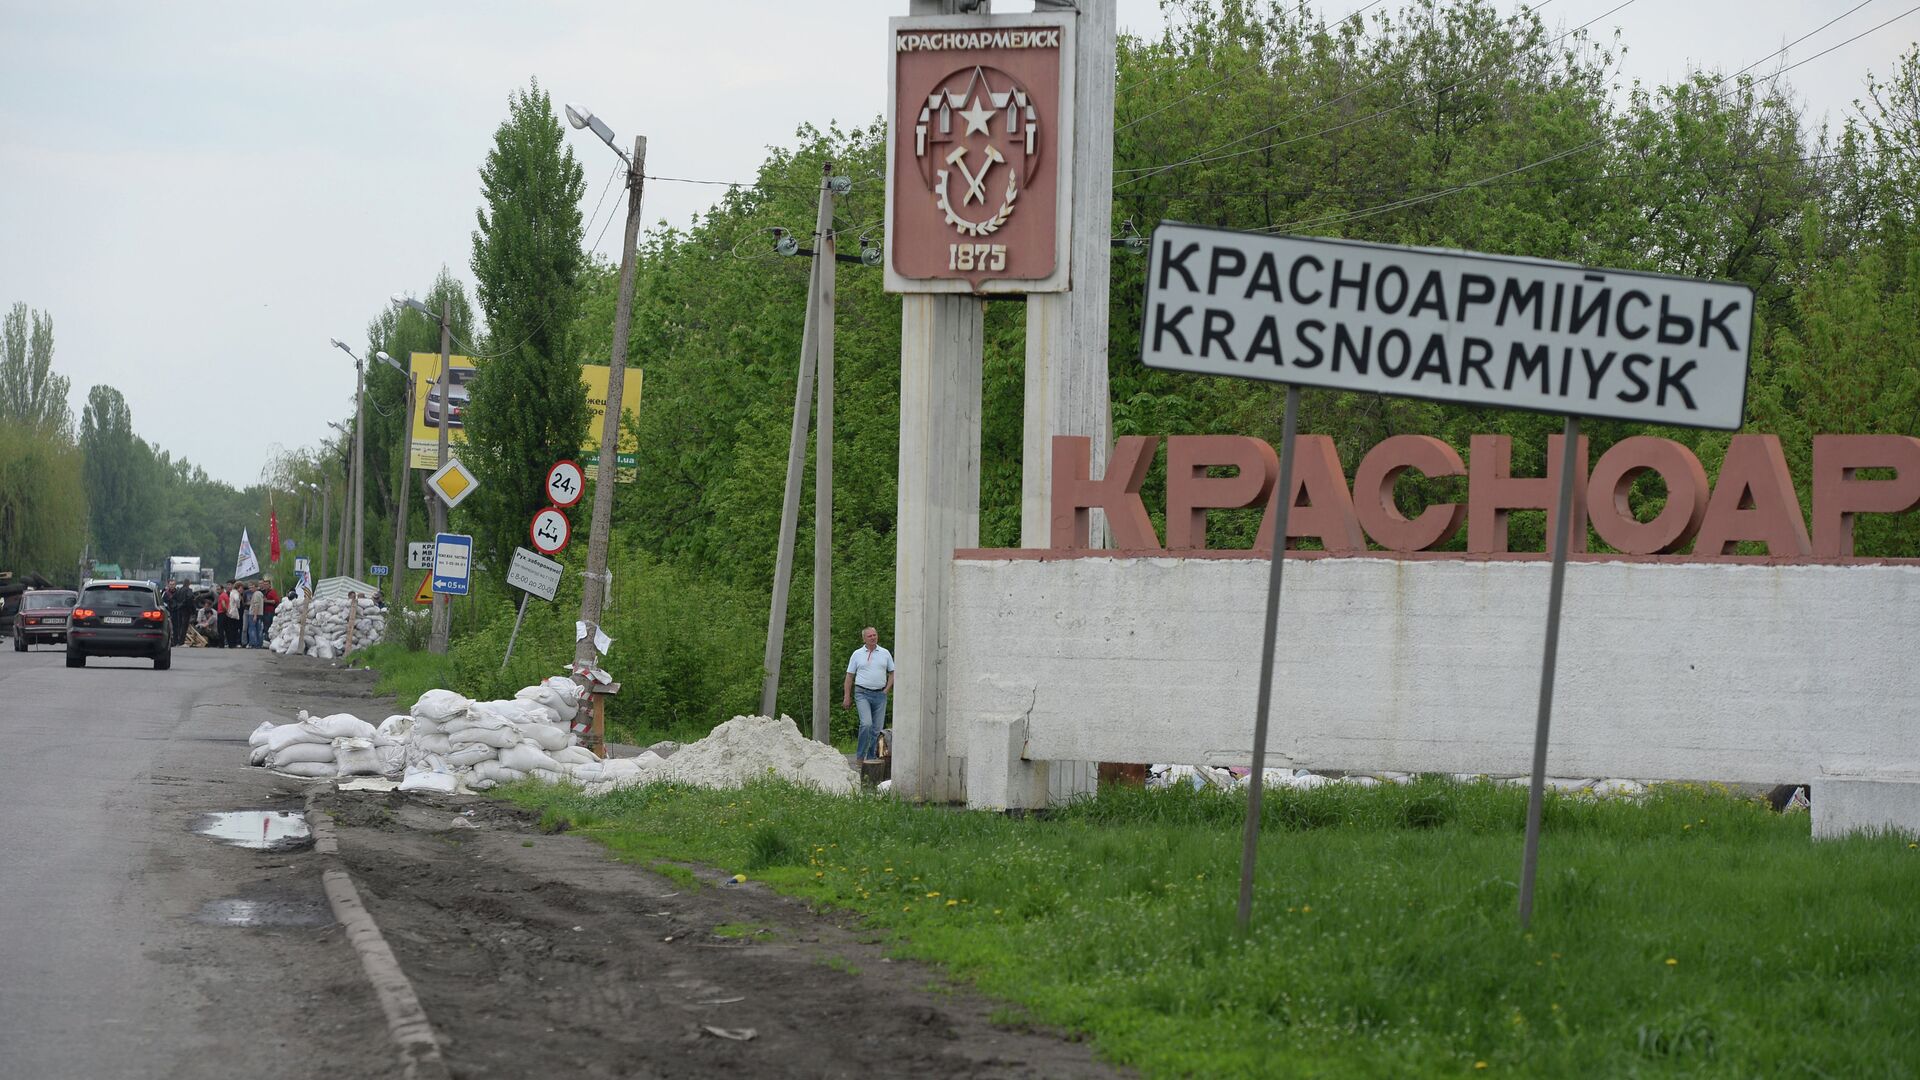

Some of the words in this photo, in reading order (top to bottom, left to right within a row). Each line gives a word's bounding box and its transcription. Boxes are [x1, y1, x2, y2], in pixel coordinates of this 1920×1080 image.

[949, 243, 1007, 271] 1875
[1158, 239, 1742, 352] КРАСНОАРМІЙСЬК
[1152, 302, 1699, 410] KRASNOARMIYSK
[1051, 433, 1920, 558] КРАСНОАР
